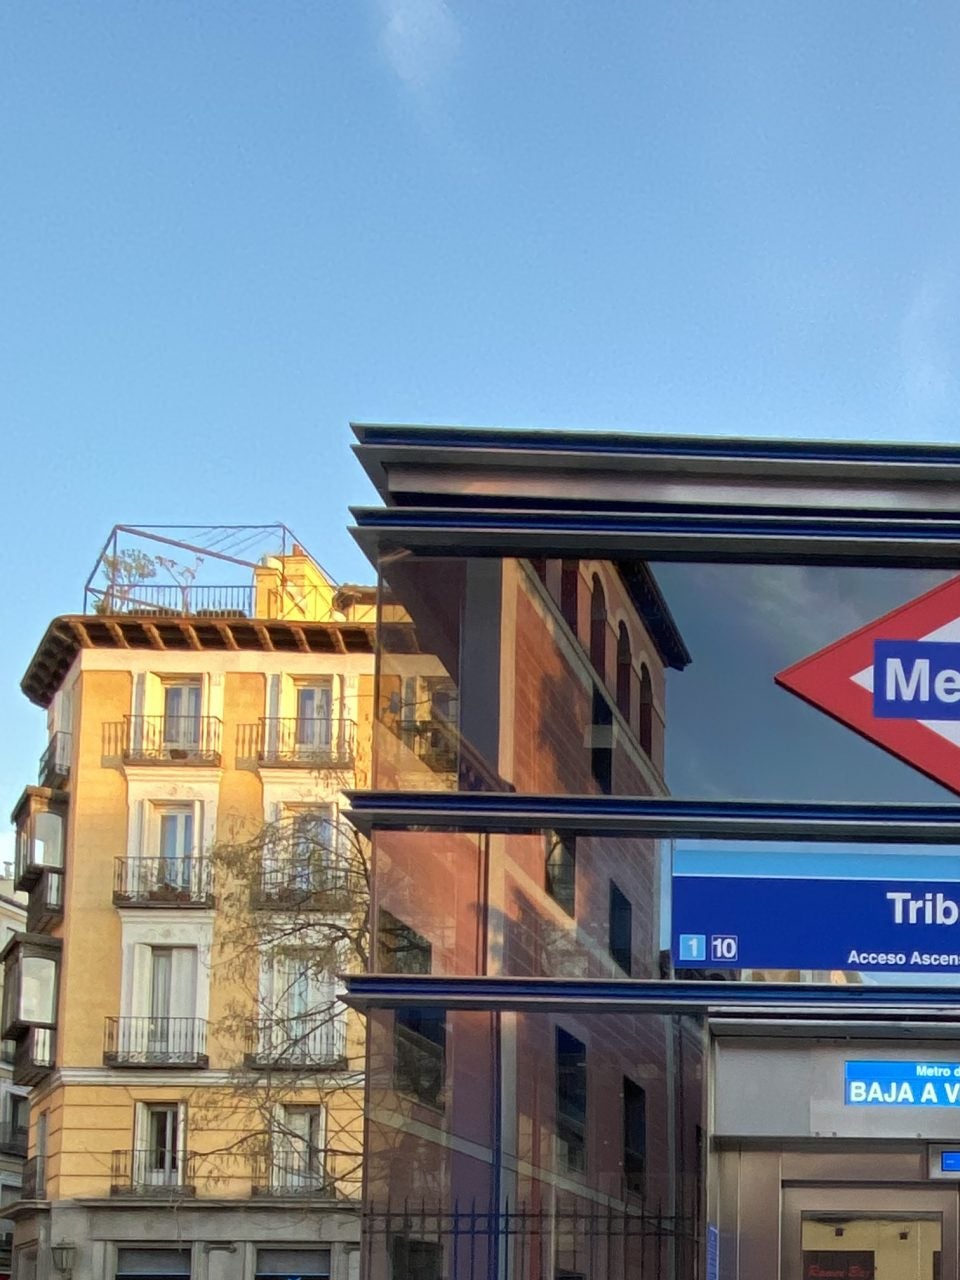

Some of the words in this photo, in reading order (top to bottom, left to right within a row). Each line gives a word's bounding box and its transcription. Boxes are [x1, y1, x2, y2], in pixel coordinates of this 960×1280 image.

[688, 938, 698, 958] 1
[712, 938, 737, 958] 10
[848, 950, 906, 965] Acceso
[916, 1065, 951, 1077] Metro
[850, 1081, 914, 1103] BAJA
[921, 1083, 938, 1103] A
